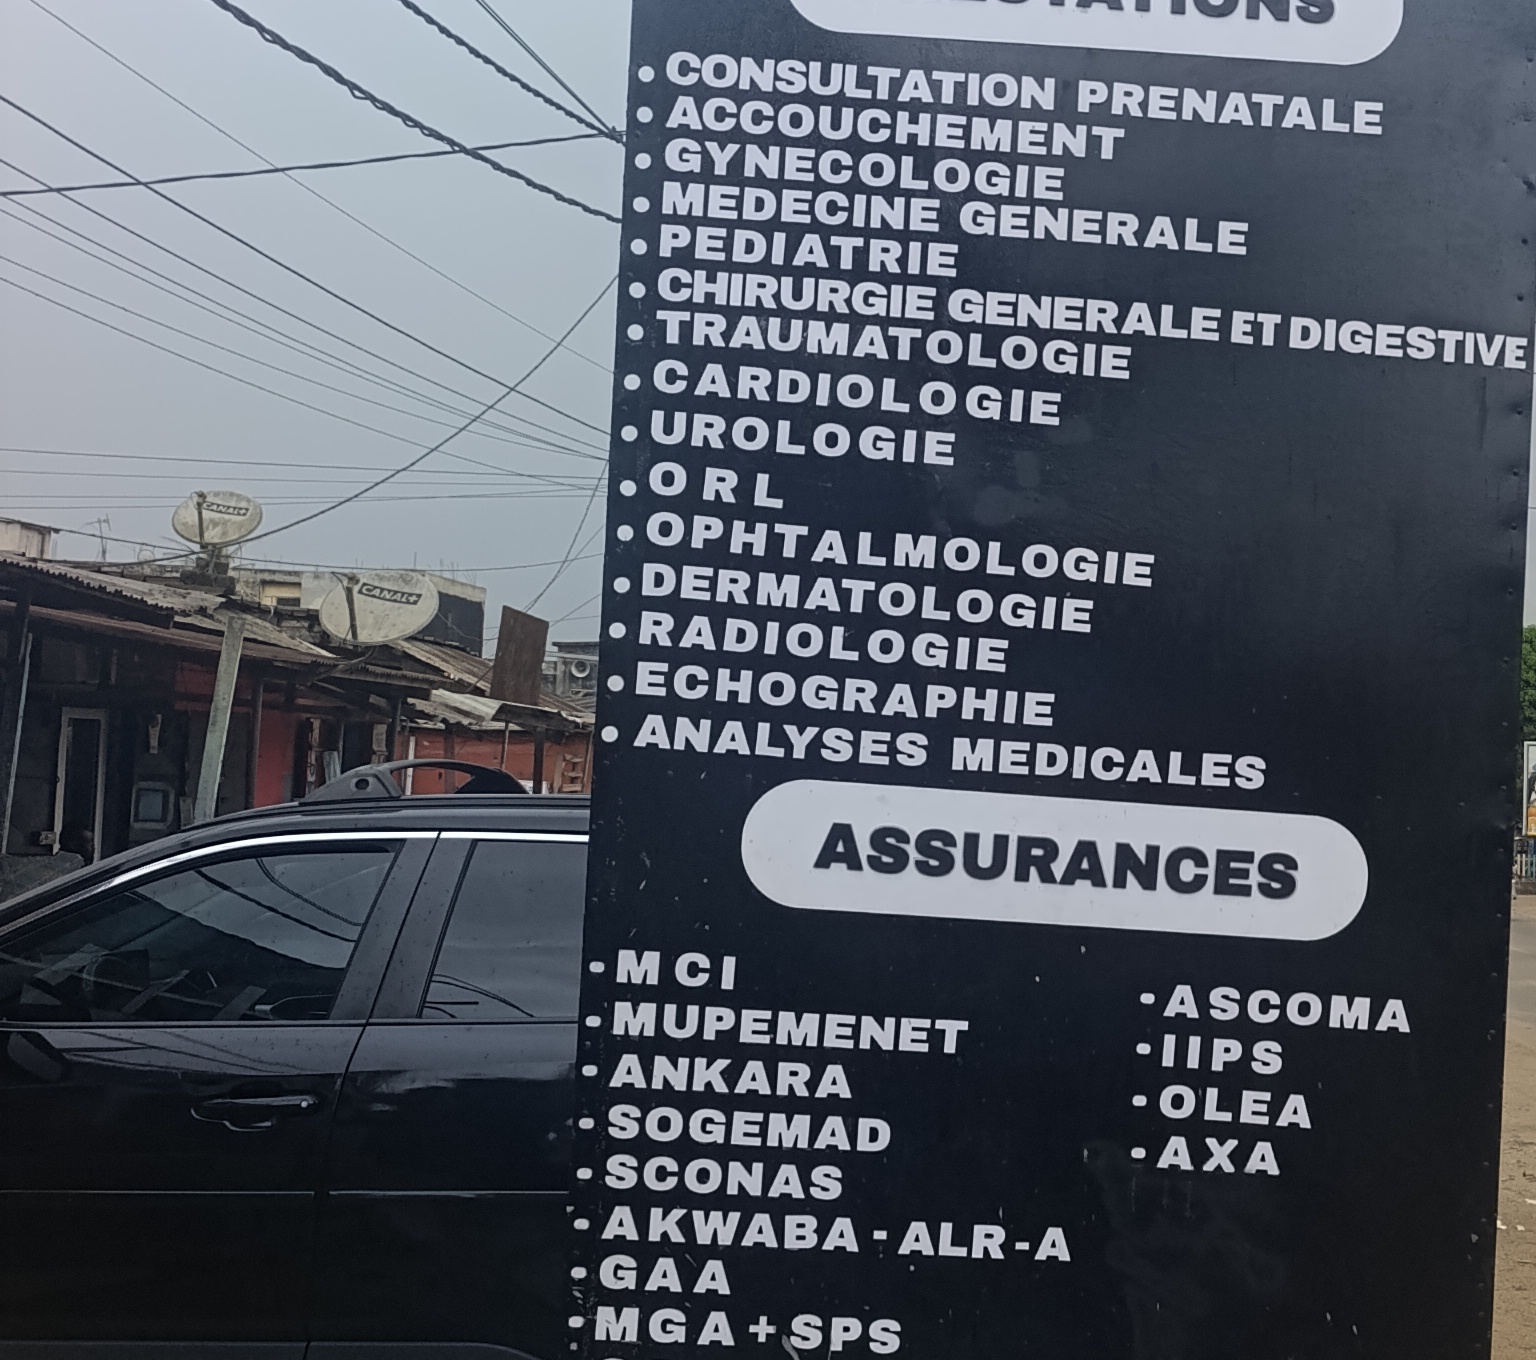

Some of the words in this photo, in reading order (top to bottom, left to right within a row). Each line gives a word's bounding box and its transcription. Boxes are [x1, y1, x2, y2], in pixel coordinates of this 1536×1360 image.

[665, 51, 1056, 111] CONSULTATION
[1077, 79, 1384, 136] PRENATALE
[665, 95, 1126, 160] ACCOUCHEMENT
[664, 137, 1065, 201] GYNECOLOGIE
[661, 180, 941, 233] MEDECINE
[959, 200, 1249, 256] GENERALE
[659, 223, 959, 278] PEDIATRIE
[655, 309, 1132, 380] TRAUMATOLOGIE
[657, 267, 937, 321] CHIRURGIE
[947, 288, 1222, 342] GENERALE
[1230, 310, 1282, 347] ET
[1288, 315, 1528, 370] DIGESTIVE
[653, 358, 1062, 427] CARDIOLOGIE
[650, 409, 956, 467] UROLOGIE
[202, 501, 248, 516] CANAL+
[646, 511, 1156, 588] OPHTALMOLOGIE
[361, 584, 419, 604] CANAL+
[641, 562, 1094, 634] DERMATOLOGIE
[638, 610, 1010, 673] RADIOLOGIE
[635, 660, 1056, 727] ECHOGRAPHIE
[633, 713, 928, 767] ANALYSES
[951, 736, 1267, 790] MEDICALES
[813, 822, 1299, 900] ASSURANCES
[612, 1001, 970, 1055] MUPEMENET
[1162, 984, 1411, 1034] ASCOMA
[608, 1053, 853, 1099] ANKARA
[1161, 1033, 1283, 1075] IIPS
[607, 1103, 892, 1152] SOGEMAD
[1159, 1084, 1312, 1130] OLEA
[604, 1153, 843, 1201] SCONAS
[1155, 1135, 1281, 1177] AXA
[599, 1254, 731, 1296] GAA
